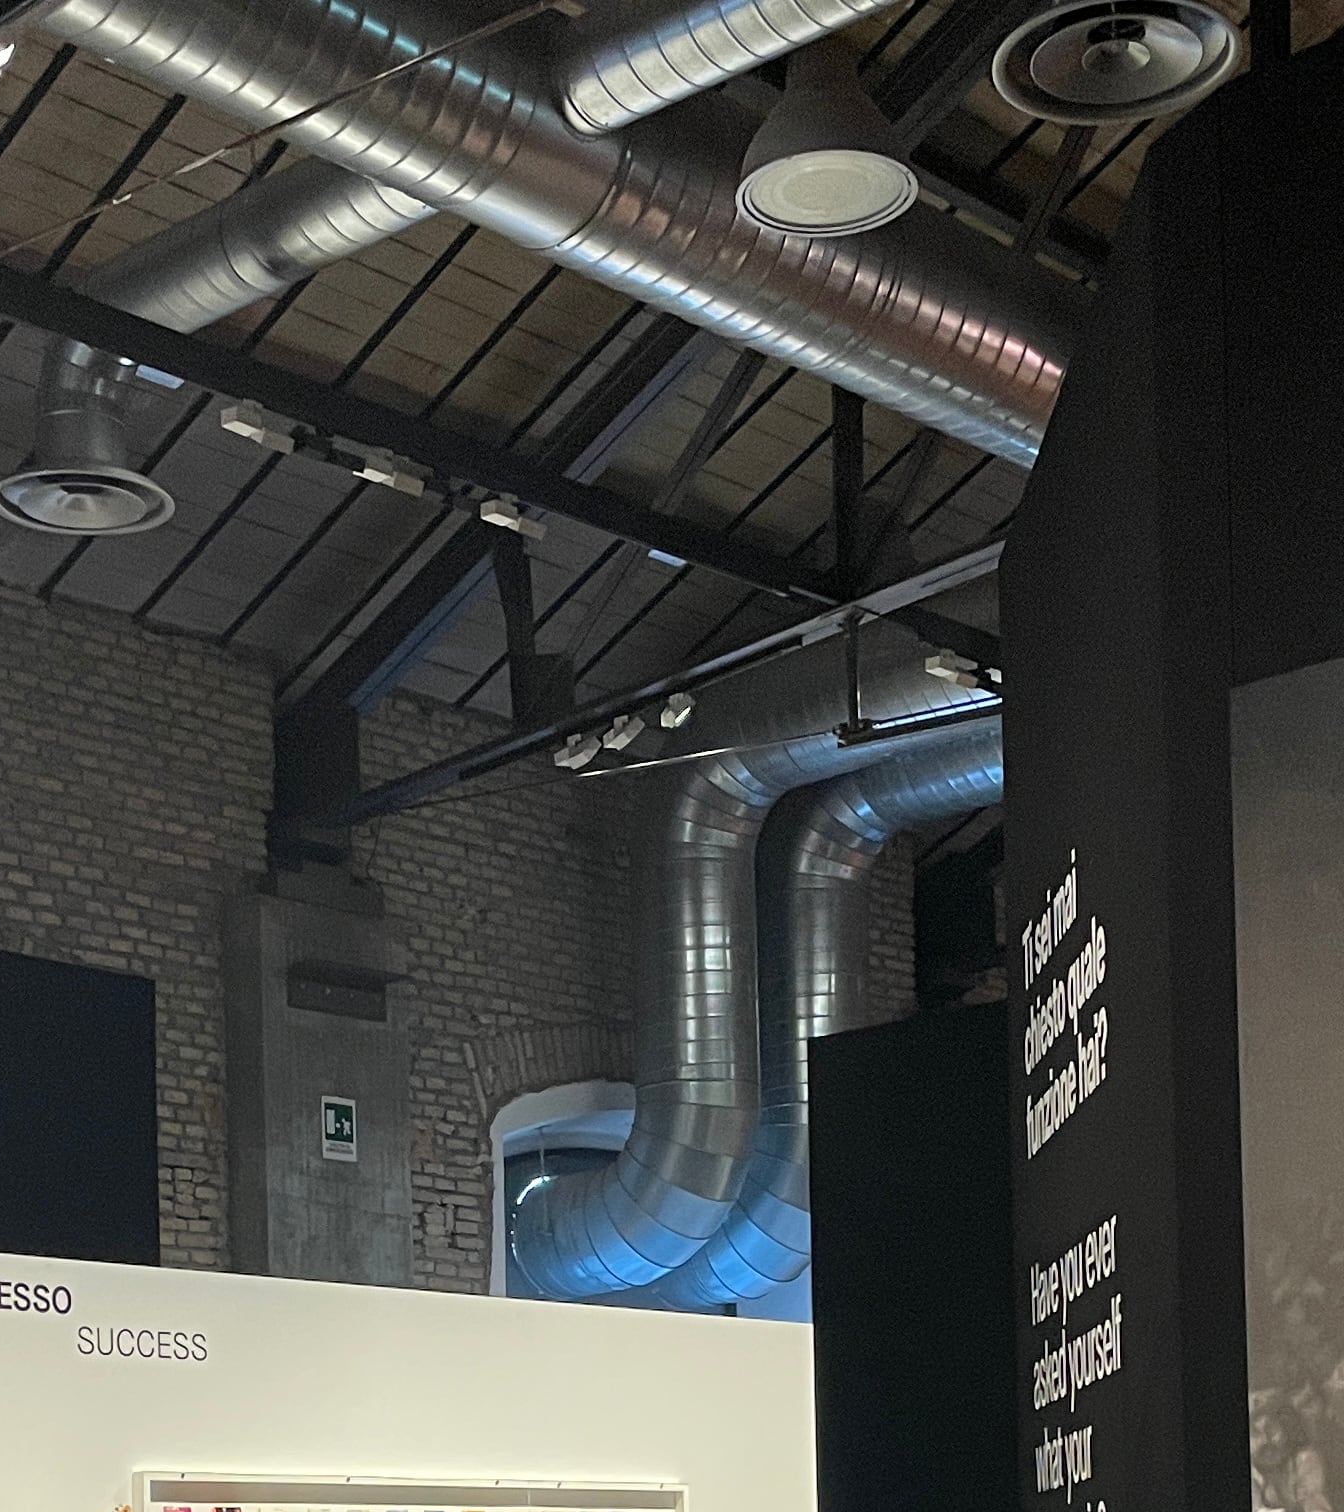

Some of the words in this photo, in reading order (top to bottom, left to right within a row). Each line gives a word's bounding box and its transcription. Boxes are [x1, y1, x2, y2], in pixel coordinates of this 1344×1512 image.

[1022, 919, 1034, 990] Ti
[1035, 889, 1052, 974] sei
[1053, 847, 1077, 947] mai
[1024, 978, 1066, 1075] chiesto
[1067, 915, 1106, 1035] quale
[1026, 1060, 1077, 1160] funzione
[1077, 1006, 1108, 1104] hai?
[1030, 1262, 1059, 1326] Have
[1059, 1242, 1084, 1326] you
[1084, 1214, 1117, 1289] ever
[77, 1326, 208, 1362] SUCCESS
[1033, 1328, 1067, 1410] asked
[1067, 1293, 1122, 1413] yourself
[1034, 1427, 1065, 1493] what
[1064, 1425, 1093, 1504] your
